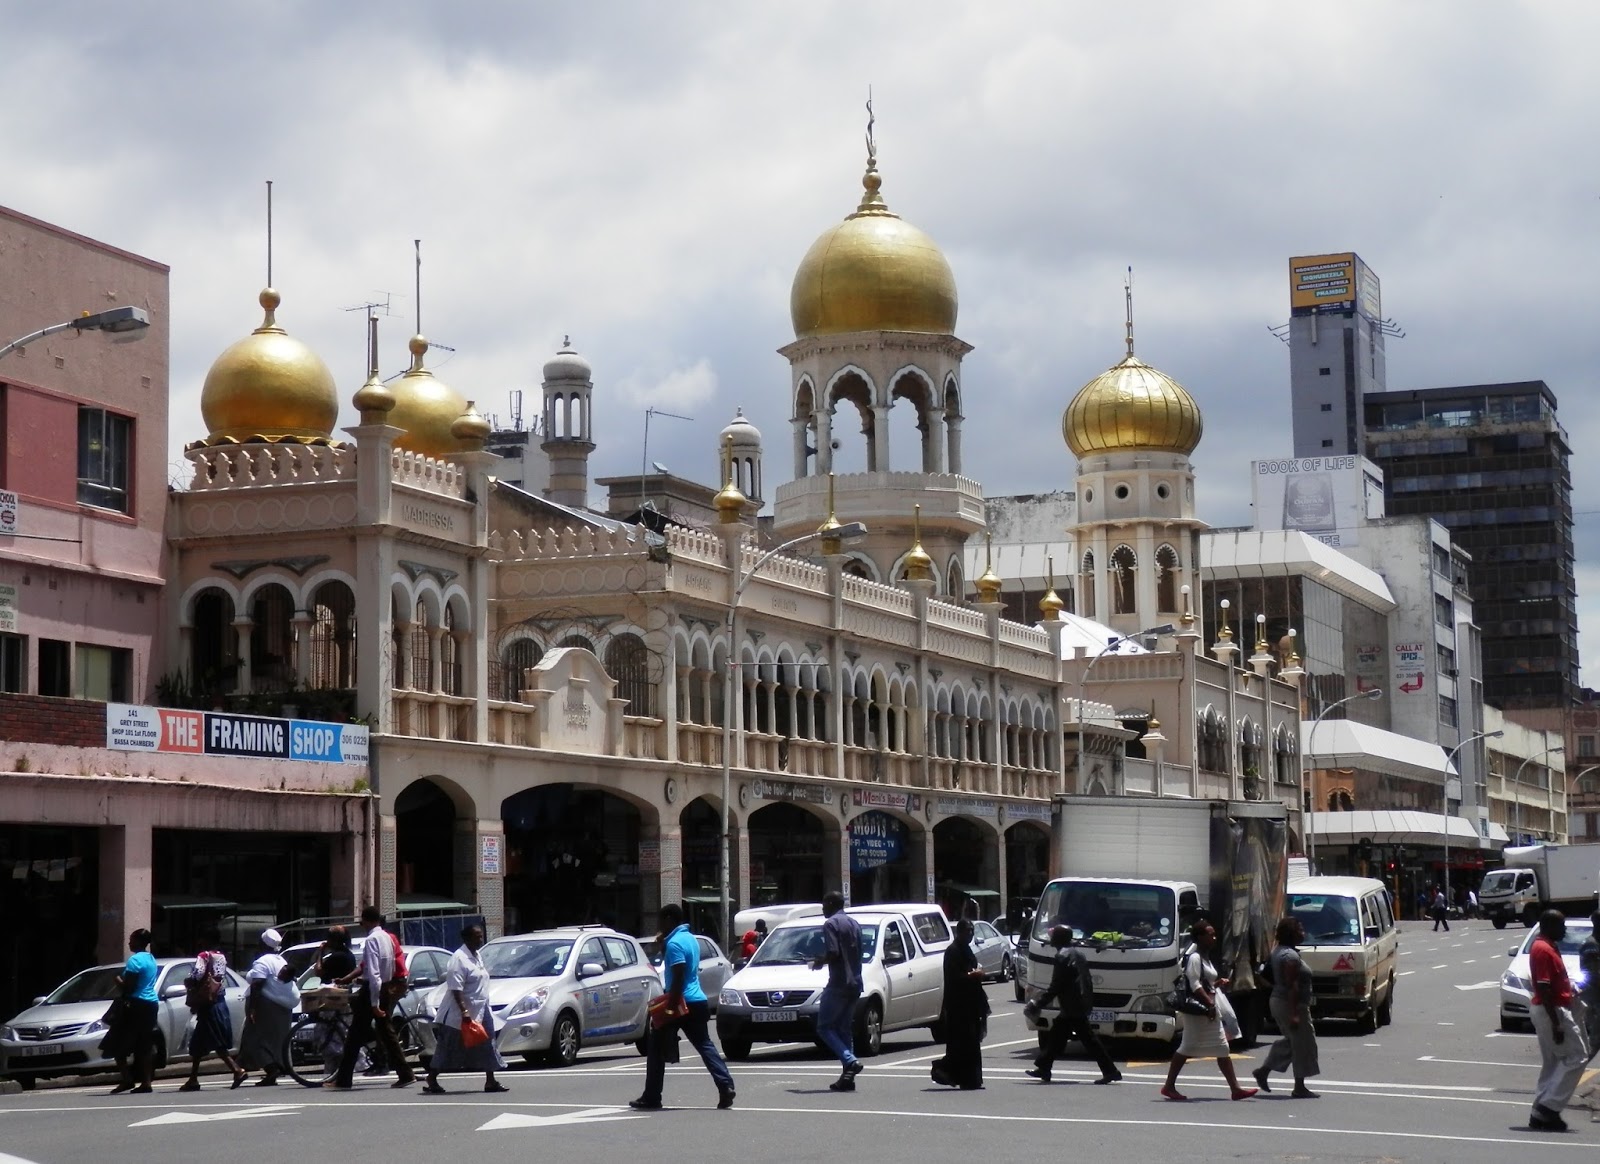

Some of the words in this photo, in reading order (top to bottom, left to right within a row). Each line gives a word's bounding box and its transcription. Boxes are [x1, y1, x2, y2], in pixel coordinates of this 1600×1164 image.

[1259, 459, 1299, 474] BOOK
[1302, 458, 1321, 471] OF
[1325, 456, 1355, 470] LIFE
[402, 503, 454, 531] MADRESSA
[1317, 535, 1340, 547] IFE
[1395, 644, 1413, 652] CALL
[128, 709, 138, 717] 141
[133, 720, 149, 728] STREET
[142, 730, 157, 738] FLOOR
[166, 715, 198, 747] THE
[211, 718, 284, 753] FRAMING
[293, 727, 334, 756] SHOP
[114, 738, 129, 746] BASSA
[130, 739, 155, 748] CHAMBERS
[342, 734, 352, 744] 306
[353, 736, 367, 746] 0229
[762, 781, 772, 795] the
[862, 790, 886, 805] Mani's
[887, 793, 906, 805] Radio
[866, 839, 882, 848] VIDEO
[887, 840, 895, 848] TV
[856, 848, 868, 856] CAR
[869, 849, 888, 857] SOUND
[1087, 1011, 1114, 1021] 75-385
